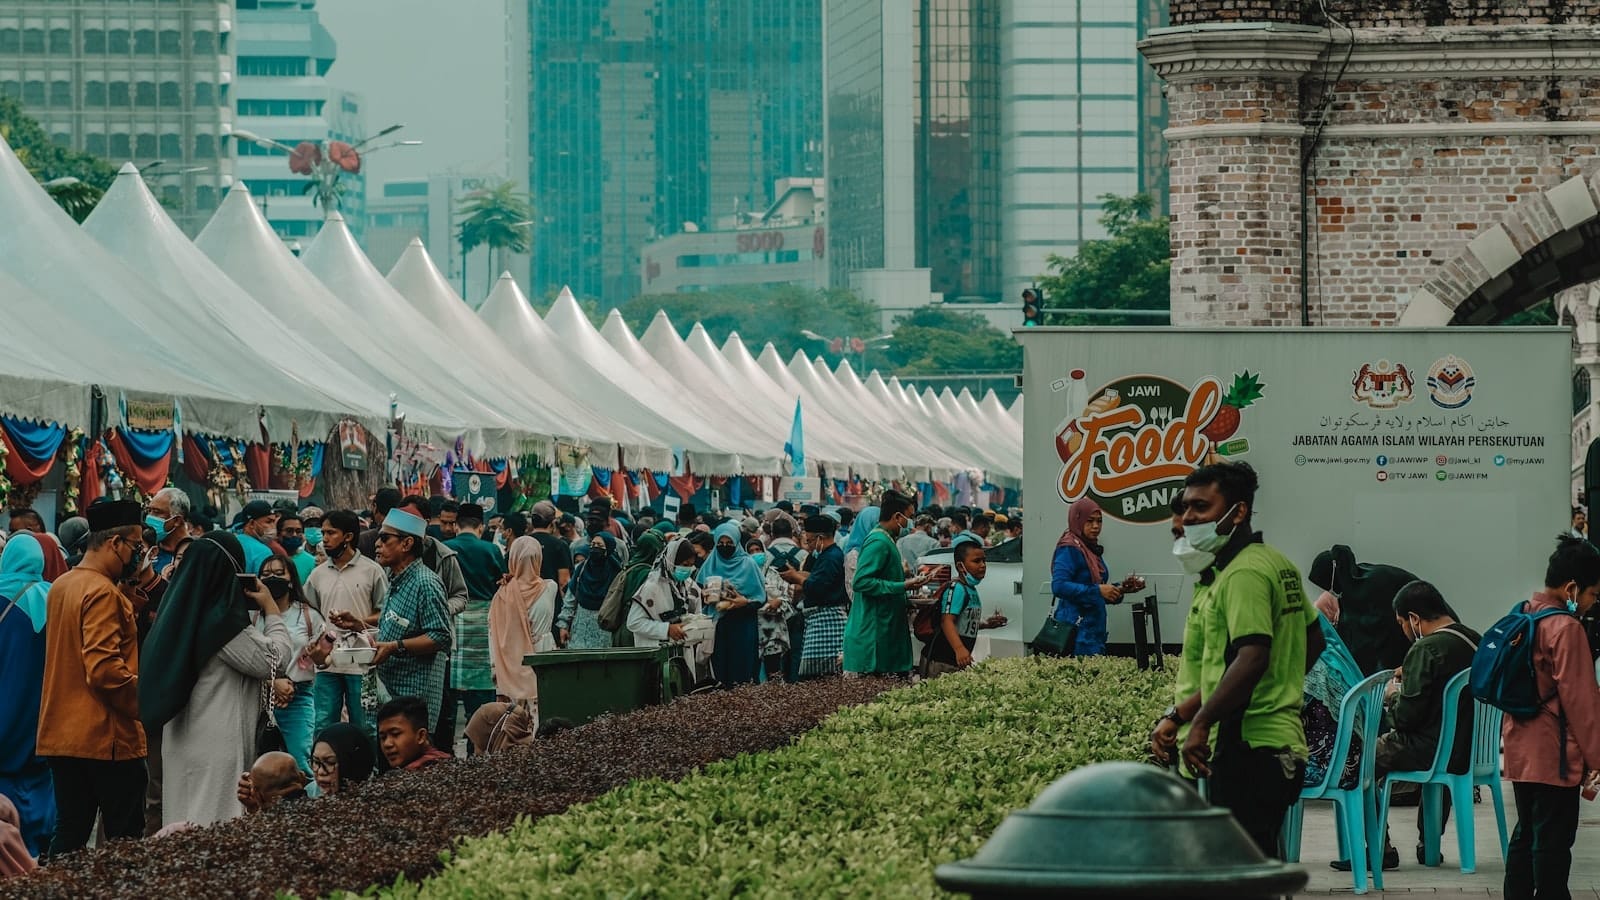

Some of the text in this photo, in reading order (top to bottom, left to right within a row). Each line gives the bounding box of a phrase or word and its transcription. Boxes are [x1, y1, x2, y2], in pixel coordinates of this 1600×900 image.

[1128, 385, 1160, 397] JAWI
[1060, 379, 1220, 499] Food
[1293, 435, 1545, 447] JABATAN AGAMA ISLAM WILAYAH PERSEKUTUAN
[1307, 456, 1371, 465] www.jawi.gov.my
[1389, 456, 1429, 464] @JAWIWP
[1506, 457, 1545, 466] @myJAWI
